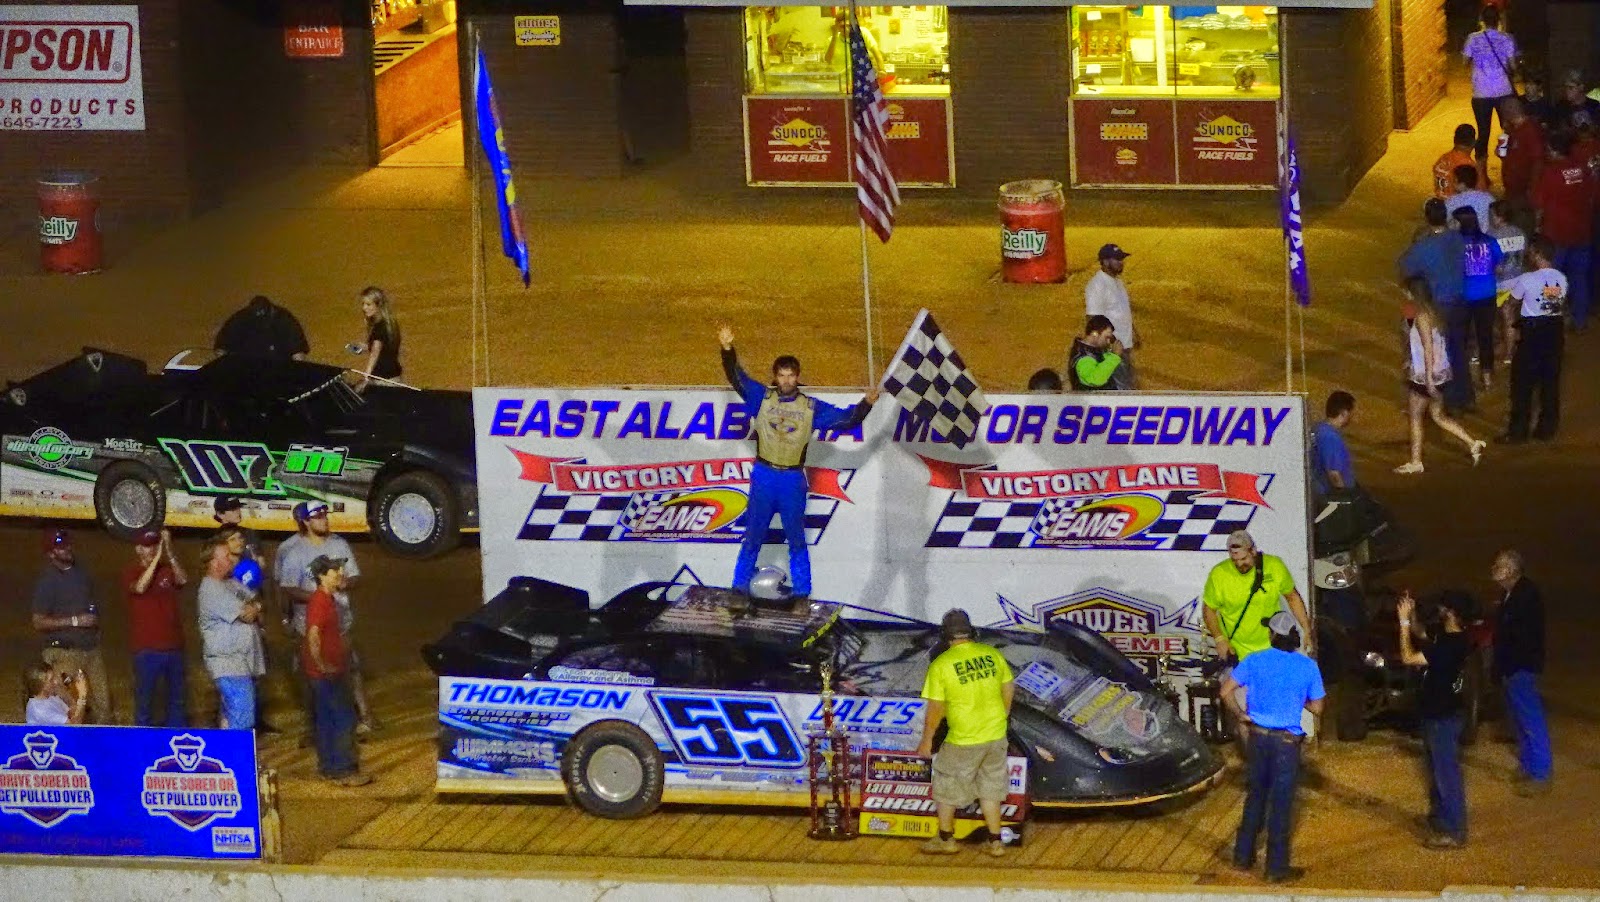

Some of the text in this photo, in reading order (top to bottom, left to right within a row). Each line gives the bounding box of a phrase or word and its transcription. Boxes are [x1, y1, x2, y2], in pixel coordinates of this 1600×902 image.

[0, 28, 114, 71] PSON
[775, 126, 823, 139] SUNOCO
[1201, 123, 1249, 136] SUNOCO
[774, 154, 828, 163] RACE FUELS
[1198, 151, 1254, 161] RACE FUELS
[489, 399, 1291, 445] EAST ALABA MOR SPEEDWAY
[571, 462, 755, 491] VICTORY LAN
[981, 467, 1199, 495] VICTORY LANE
[641, 506, 716, 531] EAMS
[1049, 512, 1130, 538] EAMS
[953, 655, 995, 675] EAMS
[595, 674, 614, 682] and
[617, 675, 653, 684] Asthma
[959, 668, 997, 685] STAFF
[656, 696, 806, 763] 55
[0, 774, 87, 788] DRIVE SOBER OR
[146, 776, 235, 791] DRIVE SOBER OR
[0, 790, 92, 804] GET PULLED OVER
[145, 792, 238, 807] GET PULLED OVER
[215, 833, 251, 844] NHTSA
